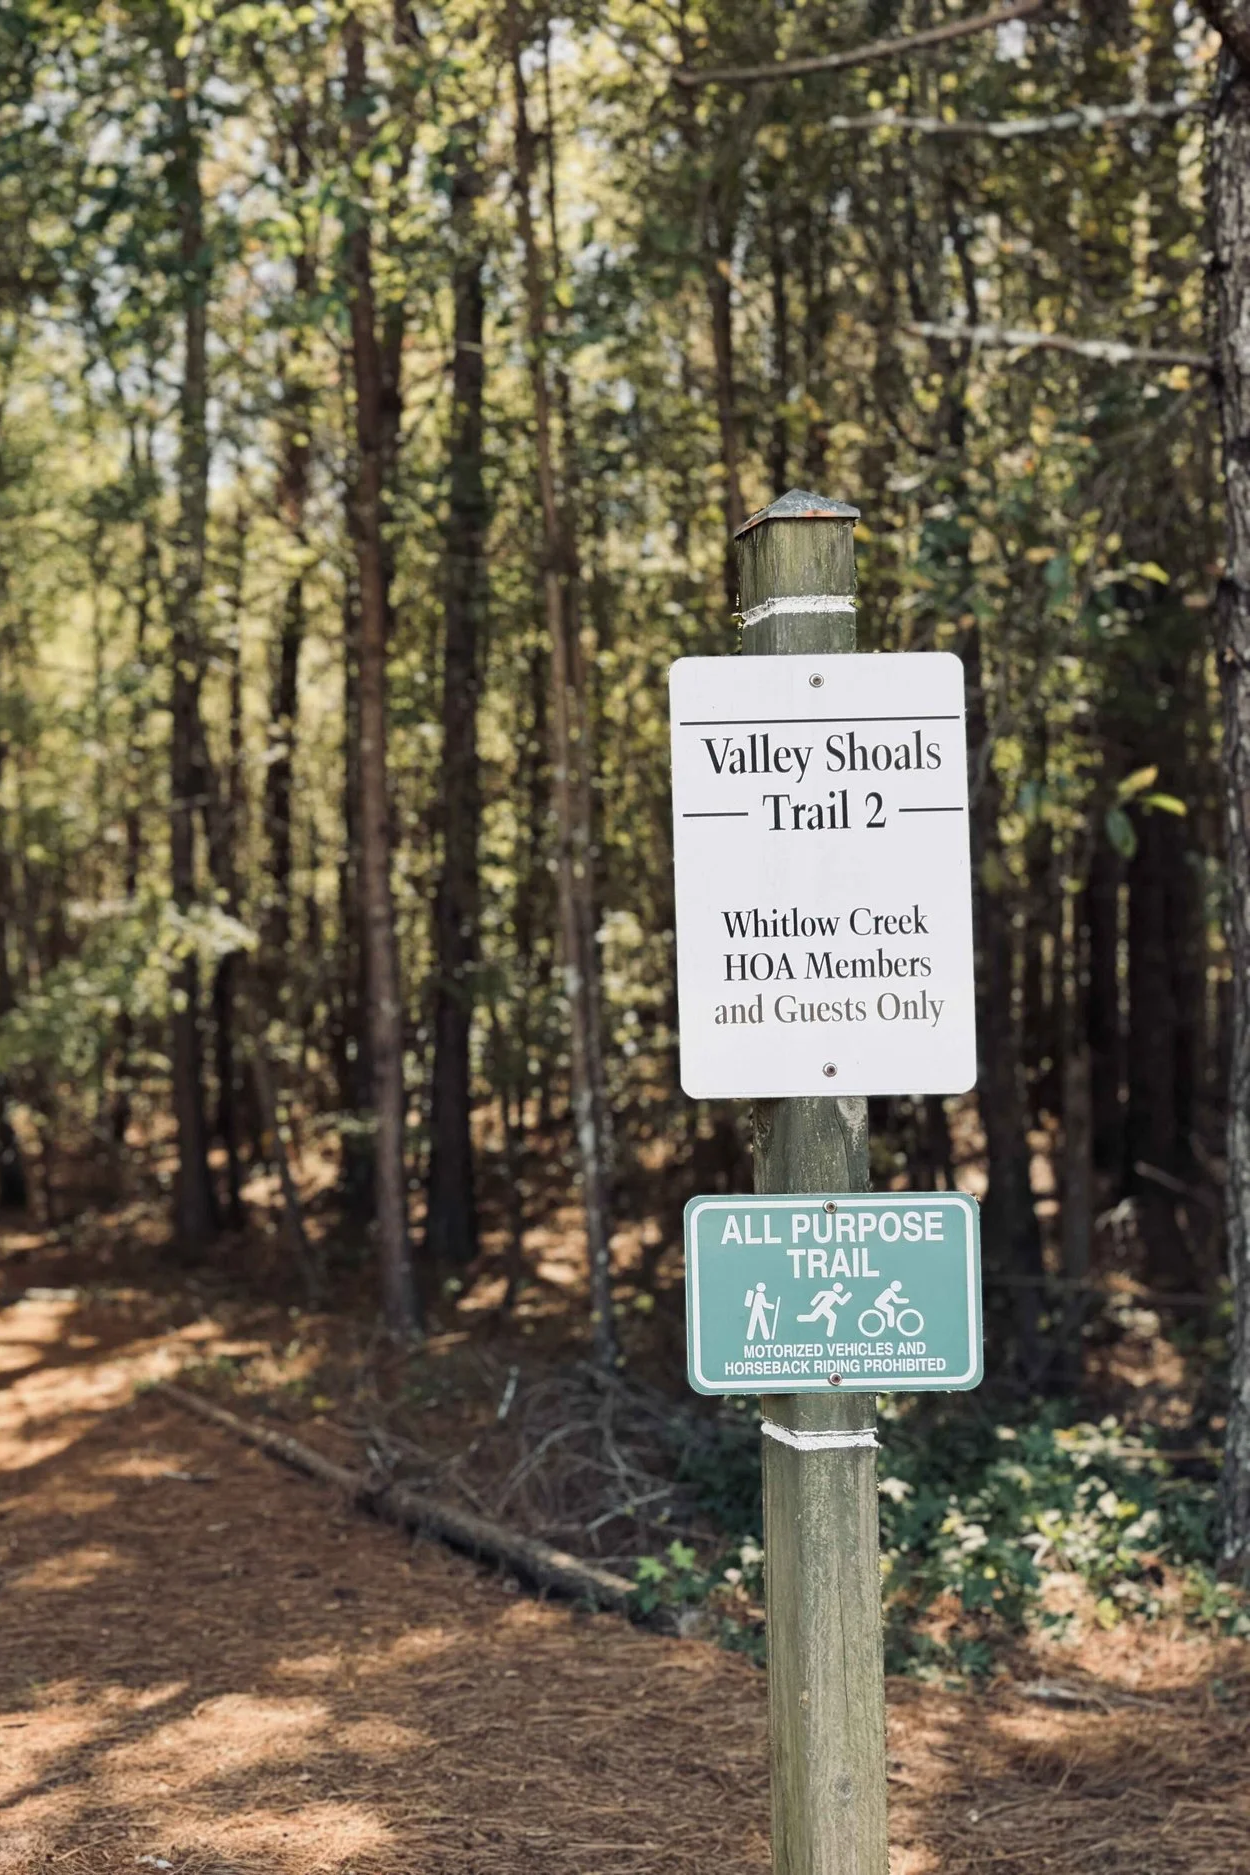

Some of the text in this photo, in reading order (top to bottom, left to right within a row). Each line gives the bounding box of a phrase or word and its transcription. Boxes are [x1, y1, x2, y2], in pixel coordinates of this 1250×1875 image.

[700, 729, 942, 783] Valley Shoals
[762, 789, 887, 831] Trail 2
[721, 904, 929, 938] Whitlow Creek
[723, 948, 932, 981] HOA Members
[714, 990, 945, 1028] and Guests Only
[720, 1211, 944, 1245] ALL PURPOSE
[786, 1247, 880, 1279] TRAIL
[724, 1357, 947, 1376] HORSEBACK RIDING PROHIBITED
[743, 1341, 926, 1359] MOTORIZED VEHICLES AND
